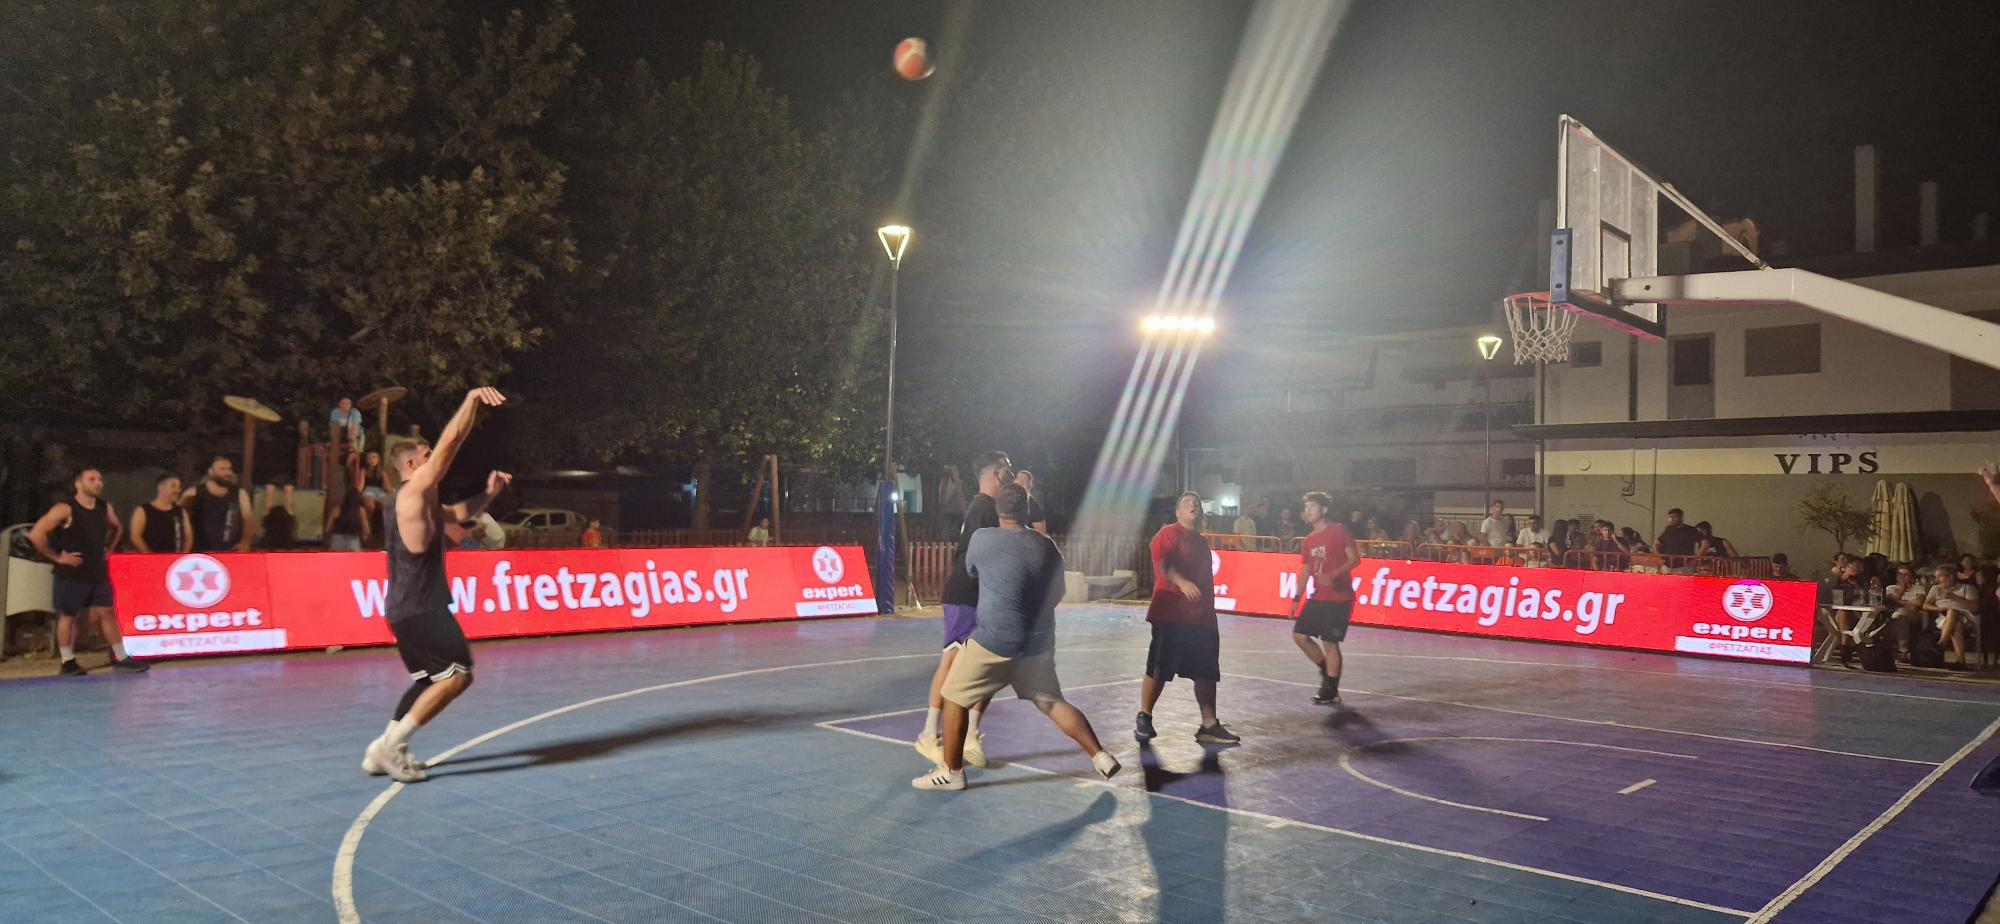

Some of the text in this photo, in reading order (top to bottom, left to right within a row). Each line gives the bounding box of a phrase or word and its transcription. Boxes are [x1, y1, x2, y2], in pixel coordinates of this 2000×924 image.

[1774, 451, 1879, 475] VIPS
[351, 559, 749, 617] ww.fretzagias.gr
[802, 583, 864, 600] expert
[1279, 567, 1625, 635] w.fretzagias.gr
[133, 607, 263, 632] expert
[1692, 622, 1794, 641] expert
